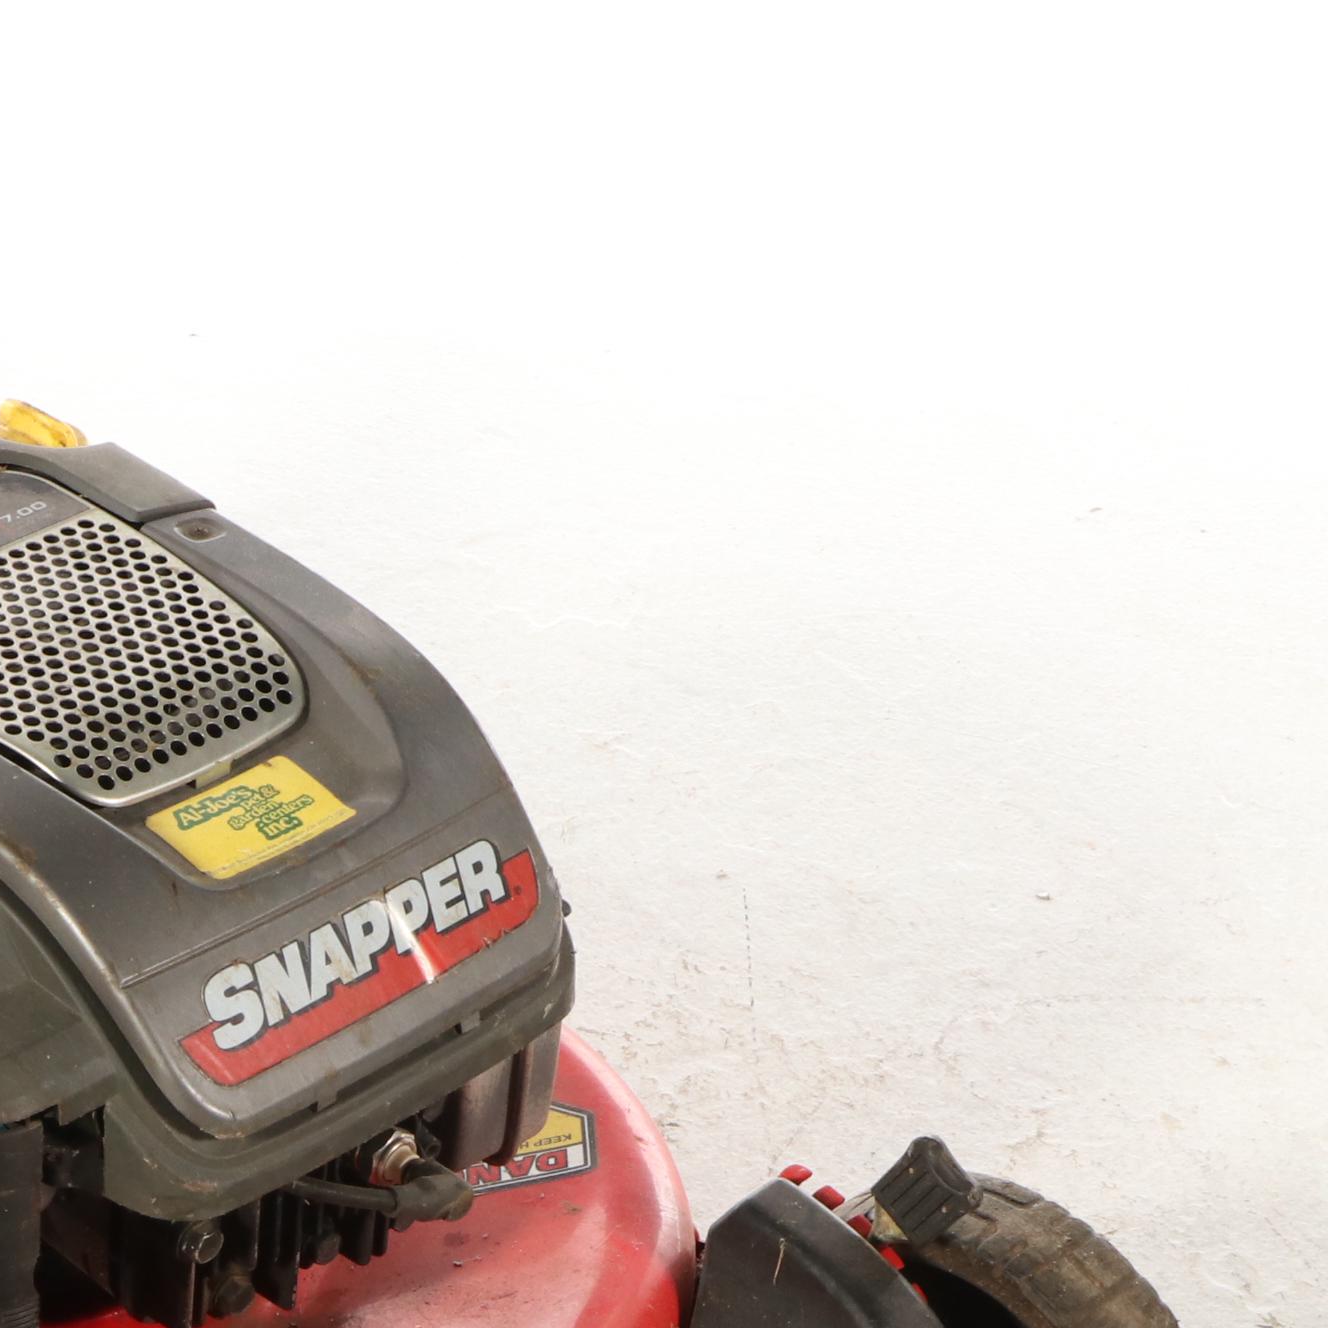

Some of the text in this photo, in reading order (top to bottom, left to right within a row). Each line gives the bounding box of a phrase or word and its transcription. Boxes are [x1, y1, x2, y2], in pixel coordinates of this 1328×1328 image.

[0, 501, 47, 523] 7.00
[179, 789, 252, 826] Al-Joe's
[262, 797, 312, 824] centers
[203, 839, 508, 1051] SNAPPER
[534, 1133, 572, 1148] KEEP
[460, 1148, 569, 1186] DAN
